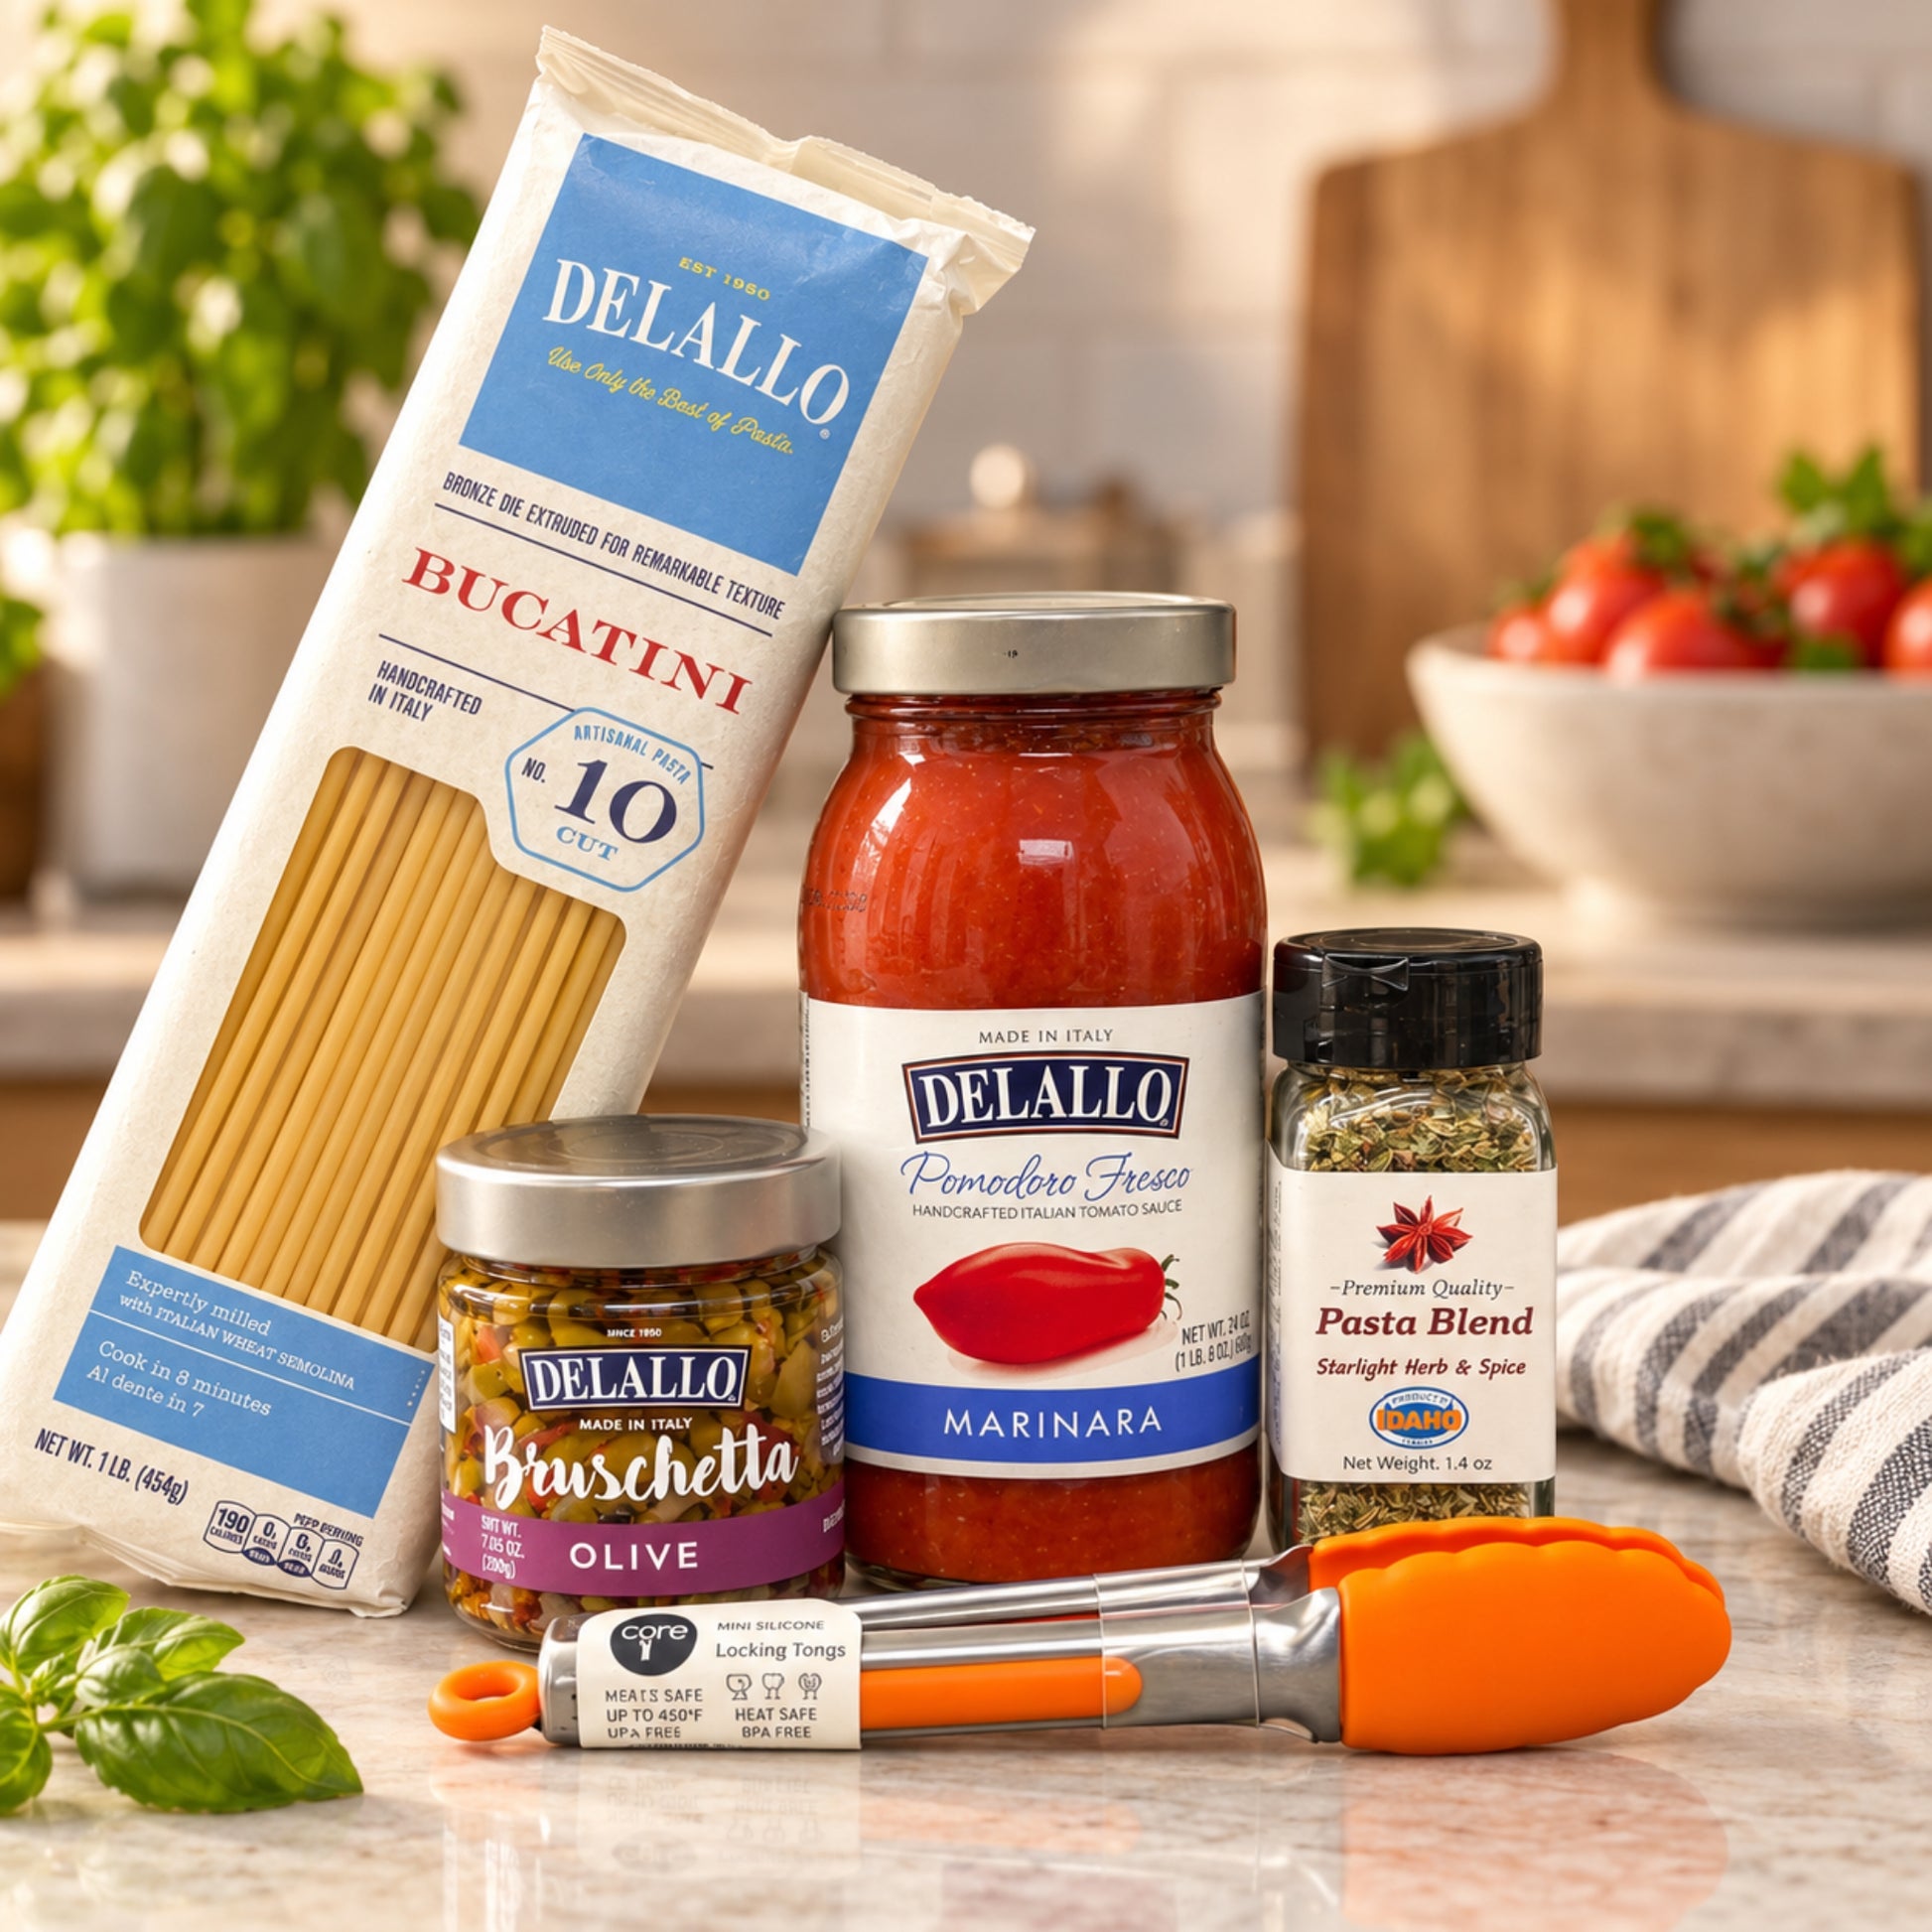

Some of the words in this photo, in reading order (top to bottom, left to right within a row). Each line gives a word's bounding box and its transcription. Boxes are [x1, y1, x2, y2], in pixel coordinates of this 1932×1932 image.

[678, 257, 717, 279] EST
[723, 273, 770, 301] 1950
[542, 258, 850, 426] DELALLO
[548, 346, 582, 373] Use
[585, 362, 627, 393] Only
[628, 376, 656, 400] the
[707, 411, 733, 432] of
[442, 471, 496, 509] BRONZE
[498, 493, 522, 519] DIE
[526, 503, 599, 546] EXTRUDED
[601, 531, 629, 558] FOR
[631, 543, 725, 596] REMARKABLE
[726, 579, 786, 621] TEXTURE
[401, 547, 753, 715] BUCATINI
[368, 683, 387, 706] IN
[389, 689, 434, 723] ITALY
[377, 660, 483, 716] HANDCRAFTED
[575, 725, 647, 756] ARTISANAL
[652, 747, 692, 785] PASTA
[521, 757, 547, 784] NO.
[554, 759, 678, 844] 10
[556, 825, 620, 862] CUT
[979, 1029, 1032, 1044] MADE
[1038, 1029, 1059, 1043] IN
[1065, 1028, 1114, 1043] ITALY
[918, 1064, 1173, 1129] DELALLO
[900, 1151, 1078, 1200] Pomodoro
[1084, 1150, 1192, 1202] Fresco
[912, 1203, 1019, 1220] HANDCRAFTED
[1021, 1204, 1077, 1220] ITALIAN
[1078, 1202, 1139, 1219] TOMATO
[1141, 1198, 1183, 1216] SAUCE
[126, 1270, 208, 1313] Expertly
[209, 1302, 273, 1336] milled
[1182, 1324, 1205, 1345] NET
[1207, 1320, 1226, 1339] WT.
[1315, 1307, 1417, 1335] Pasta
[1427, 1307, 1534, 1335] Blend
[119, 1293, 154, 1317] with
[155, 1309, 218, 1341] ITALIAN
[221, 1329, 277, 1361] WHEAT
[278, 1351, 356, 1391] SEMOLINA
[1175, 1351, 1185, 1372] (1
[1189, 1348, 1206, 1366] LB.
[1208, 1344, 1214, 1362] 8
[98, 1339, 147, 1372] Cook
[150, 1359, 172, 1382] in
[175, 1369, 190, 1387] 8
[192, 1377, 273, 1417] minutes
[529, 1356, 737, 1403] DELALLO
[1316, 1358, 1399, 1381] Starlight
[1405, 1358, 1448, 1375] Herb
[1455, 1359, 1471, 1376] &
[1478, 1358, 1526, 1380] Spice
[86, 1364, 108, 1384] Al
[111, 1373, 165, 1405] dente
[167, 1392, 188, 1414] in
[192, 1401, 206, 1419] 7
[579, 1418, 624, 1431] MADE
[628, 1418, 645, 1431] IN
[651, 1417, 693, 1430] ITALY
[943, 1406, 1163, 1440] MARINARA
[1376, 1409, 1462, 1431] IDAHO
[35, 1428, 69, 1457] NET
[67, 1442, 92, 1469] WT.
[97, 1450, 108, 1471] 1
[106, 1454, 131, 1483] LB.
[133, 1464, 189, 1506] (454g)
[483, 1424, 799, 1511] Bruschetta
[1343, 1455, 1372, 1470] Net
[1376, 1455, 1440, 1472] Weight.
[1446, 1455, 1468, 1470] 1.4
[1473, 1458, 1492, 1470] oz
[217, 1507, 250, 1534] 190
[569, 1542, 698, 1571] OLIVE
[621, 1622, 688, 1641] core
[717, 1621, 751, 1631] MINI
[756, 1620, 824, 1631] SILICONE
[716, 1643, 787, 1661] Locking
[792, 1643, 846, 1661] Tongs
[664, 1689, 703, 1702] SAFE
[607, 1709, 628, 1723] UP
[632, 1709, 653, 1722] TO
[646, 1726, 681, 1738] FREE
[735, 1708, 776, 1722] HEAT
[779, 1708, 817, 1721] SAFE
[743, 1726, 770, 1738] BPA
[775, 1726, 811, 1737] FREE
